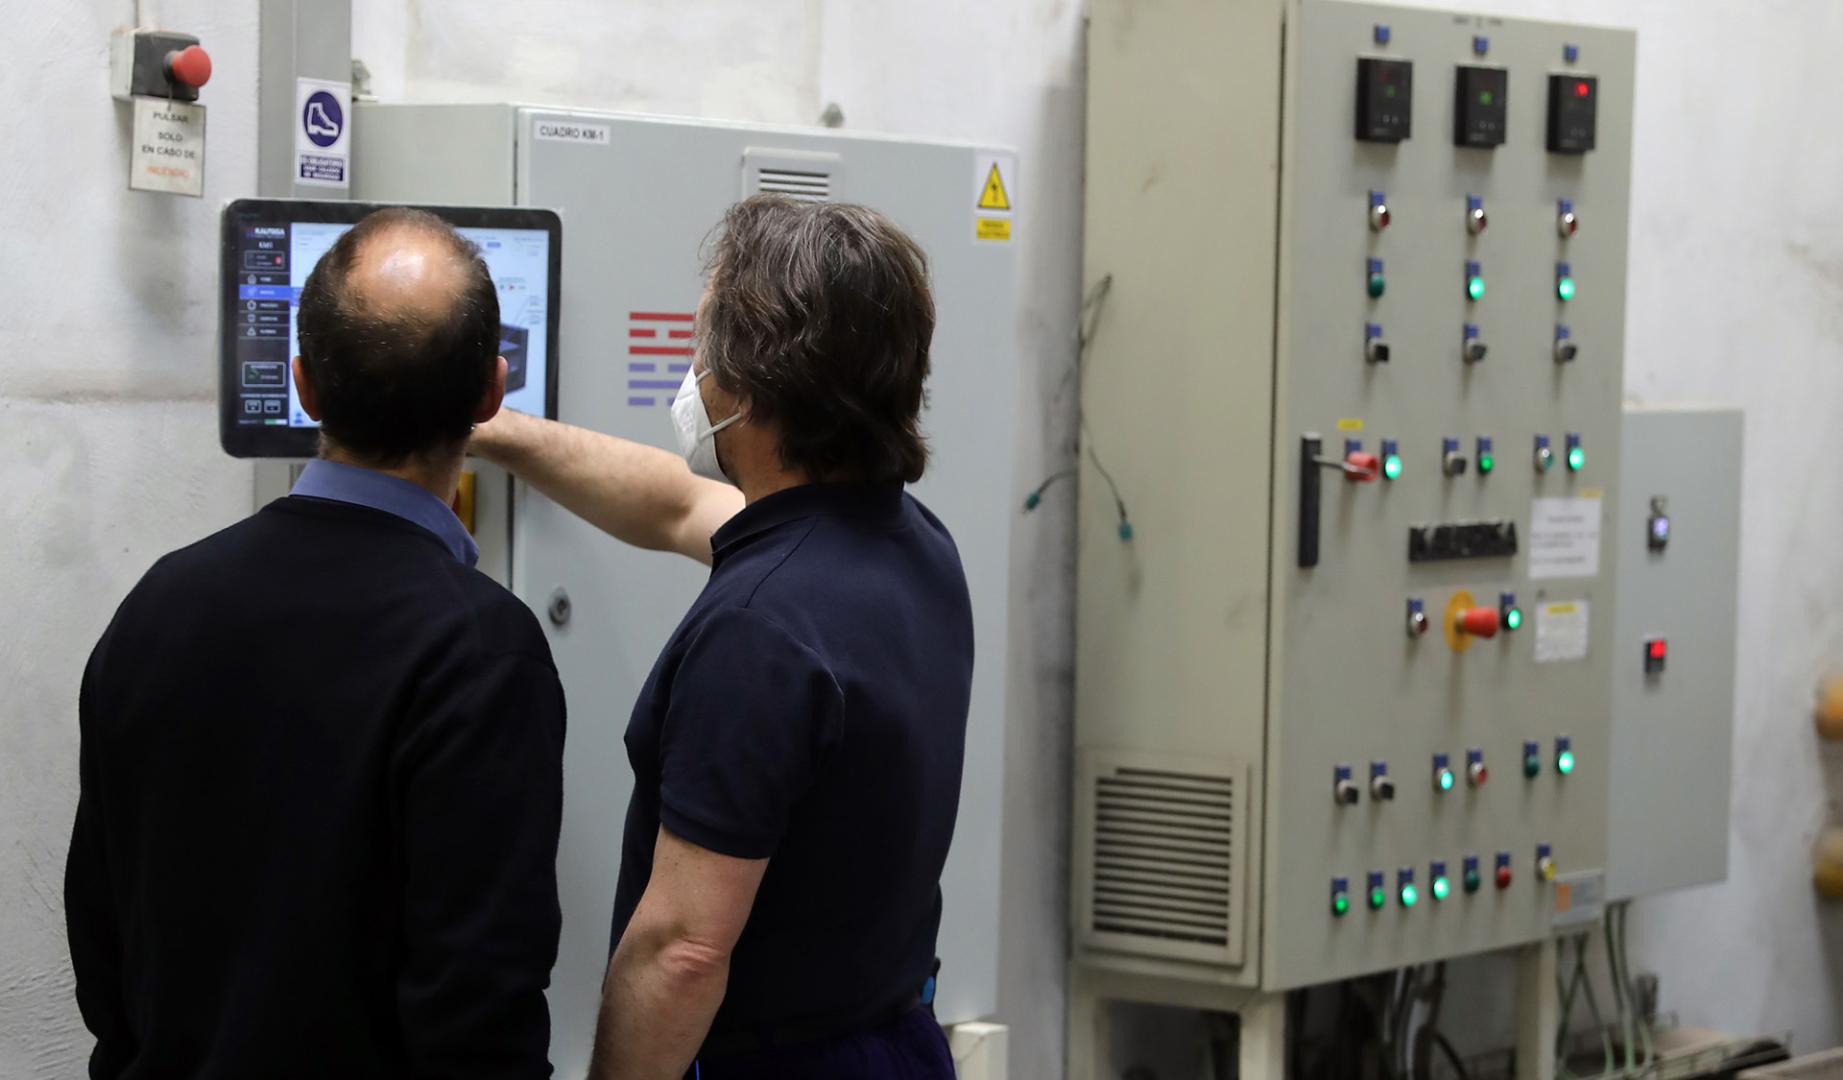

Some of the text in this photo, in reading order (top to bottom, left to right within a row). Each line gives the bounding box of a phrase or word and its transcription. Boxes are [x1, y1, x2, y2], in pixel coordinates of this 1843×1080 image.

[153, 111, 189, 123] PULSAR
[158, 131, 183, 143] SOLO
[540, 125, 604, 141] CUADRO KM-1
[142, 144, 196, 159] EN CASO DE
